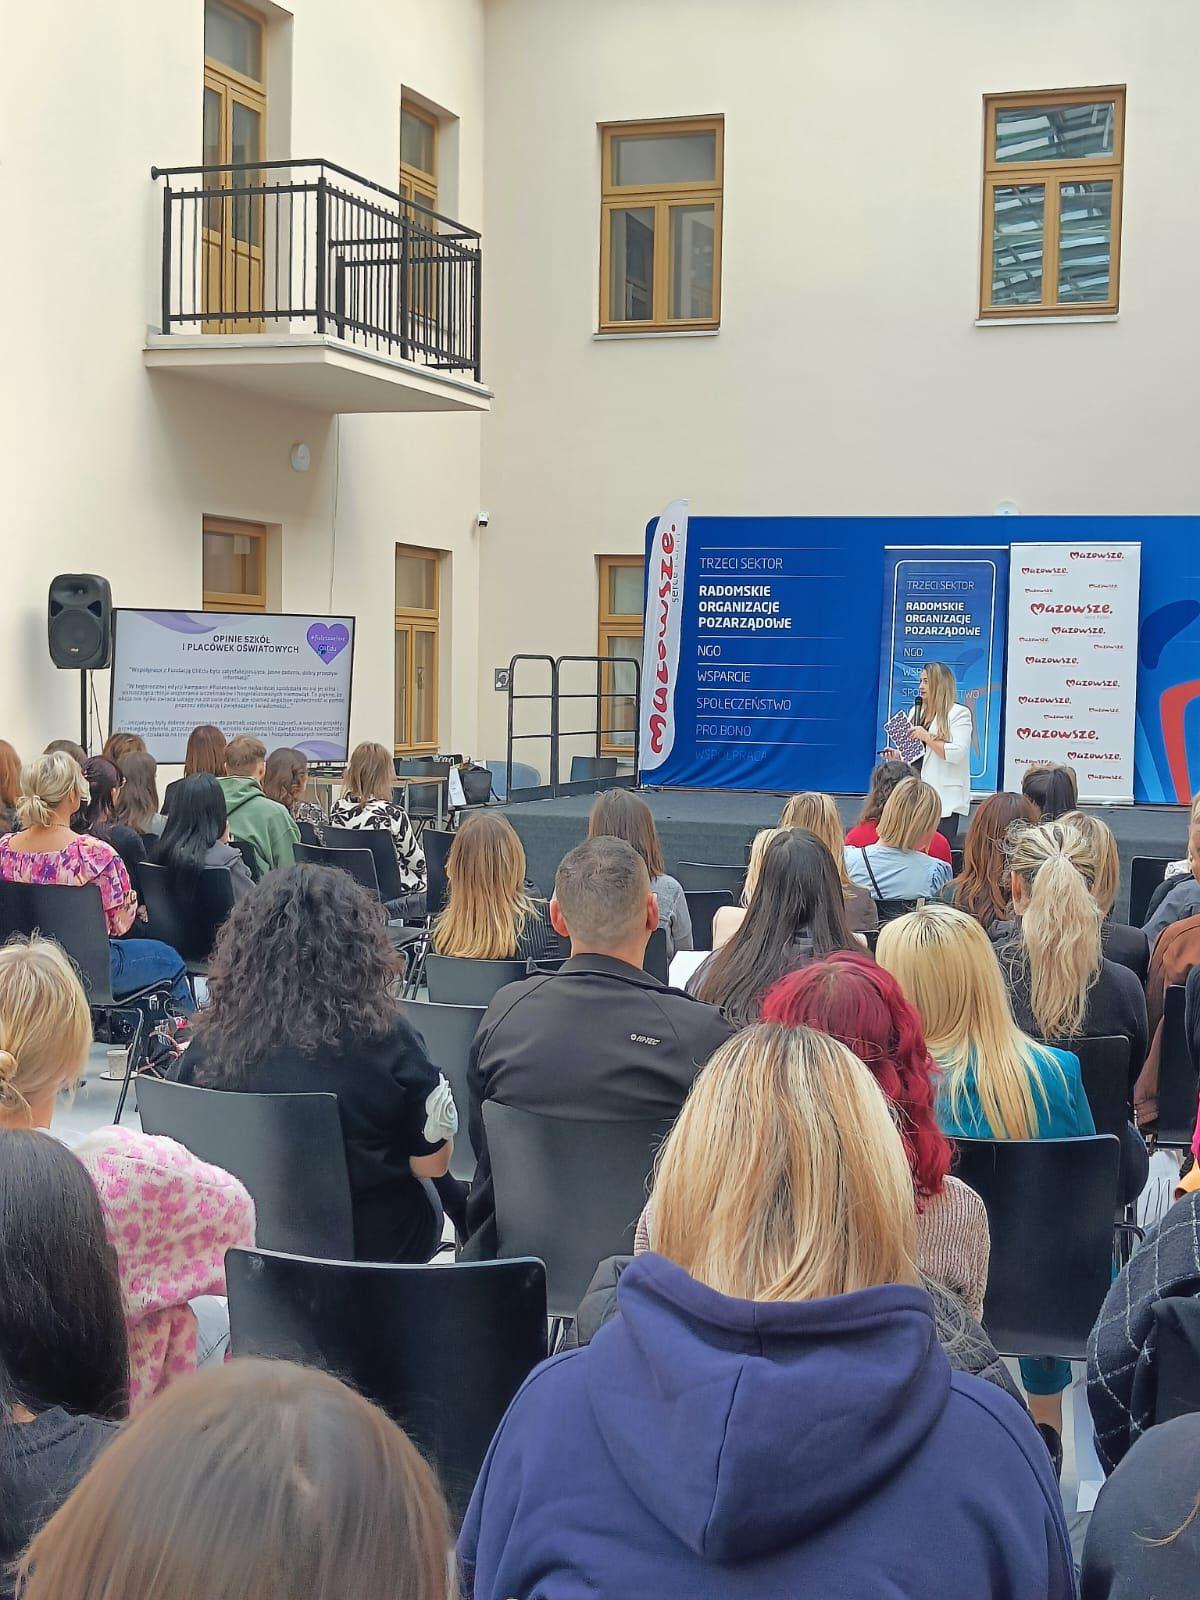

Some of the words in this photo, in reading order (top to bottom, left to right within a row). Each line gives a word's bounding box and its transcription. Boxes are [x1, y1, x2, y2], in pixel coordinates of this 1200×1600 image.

[1070, 551, 1124, 560] Mazowsze.
[699, 557, 738, 570] TRZECI
[740, 557, 783, 570] SEKTOR
[907, 580, 938, 590] TRZECI
[940, 580, 975, 590] SEKTOR
[698, 585, 771, 597] RADOMSKIE
[698, 601, 780, 615] ORGANIZACJE
[905, 602, 965, 611] RADOMSKIE
[1030, 602, 1113, 616] Mazowsze.
[698, 617, 792, 631] POZARZĄDOWE
[905, 614, 971, 624] ORGANIZACJE
[905, 626, 981, 637] POZARZĄDOWE
[1051, 626, 1106, 635] Mazowsze.
[213, 634, 242, 643] OPINIE
[244, 634, 271, 644] SZKÓŁ
[186, 642, 234, 652] PLACÓWEK
[236, 643, 299, 653] OŚWIATOWYCH
[697, 645, 721, 657] NGO
[903, 647, 923, 657] NGO
[1025, 656, 1079, 665] Mazowsze.
[697, 670, 751, 683] WSPARCIE
[1065, 679, 1120, 688] Mazowsze.
[696, 696, 792, 711] SPOŁECZEŃSTWO
[1018, 695, 1072, 705] Mazowsze.
[696, 724, 717, 736] PRO
[720, 725, 752, 737] BONO
[1016, 727, 1099, 740] Mazowsze.
[1067, 751, 1121, 760] Mazowsze.
